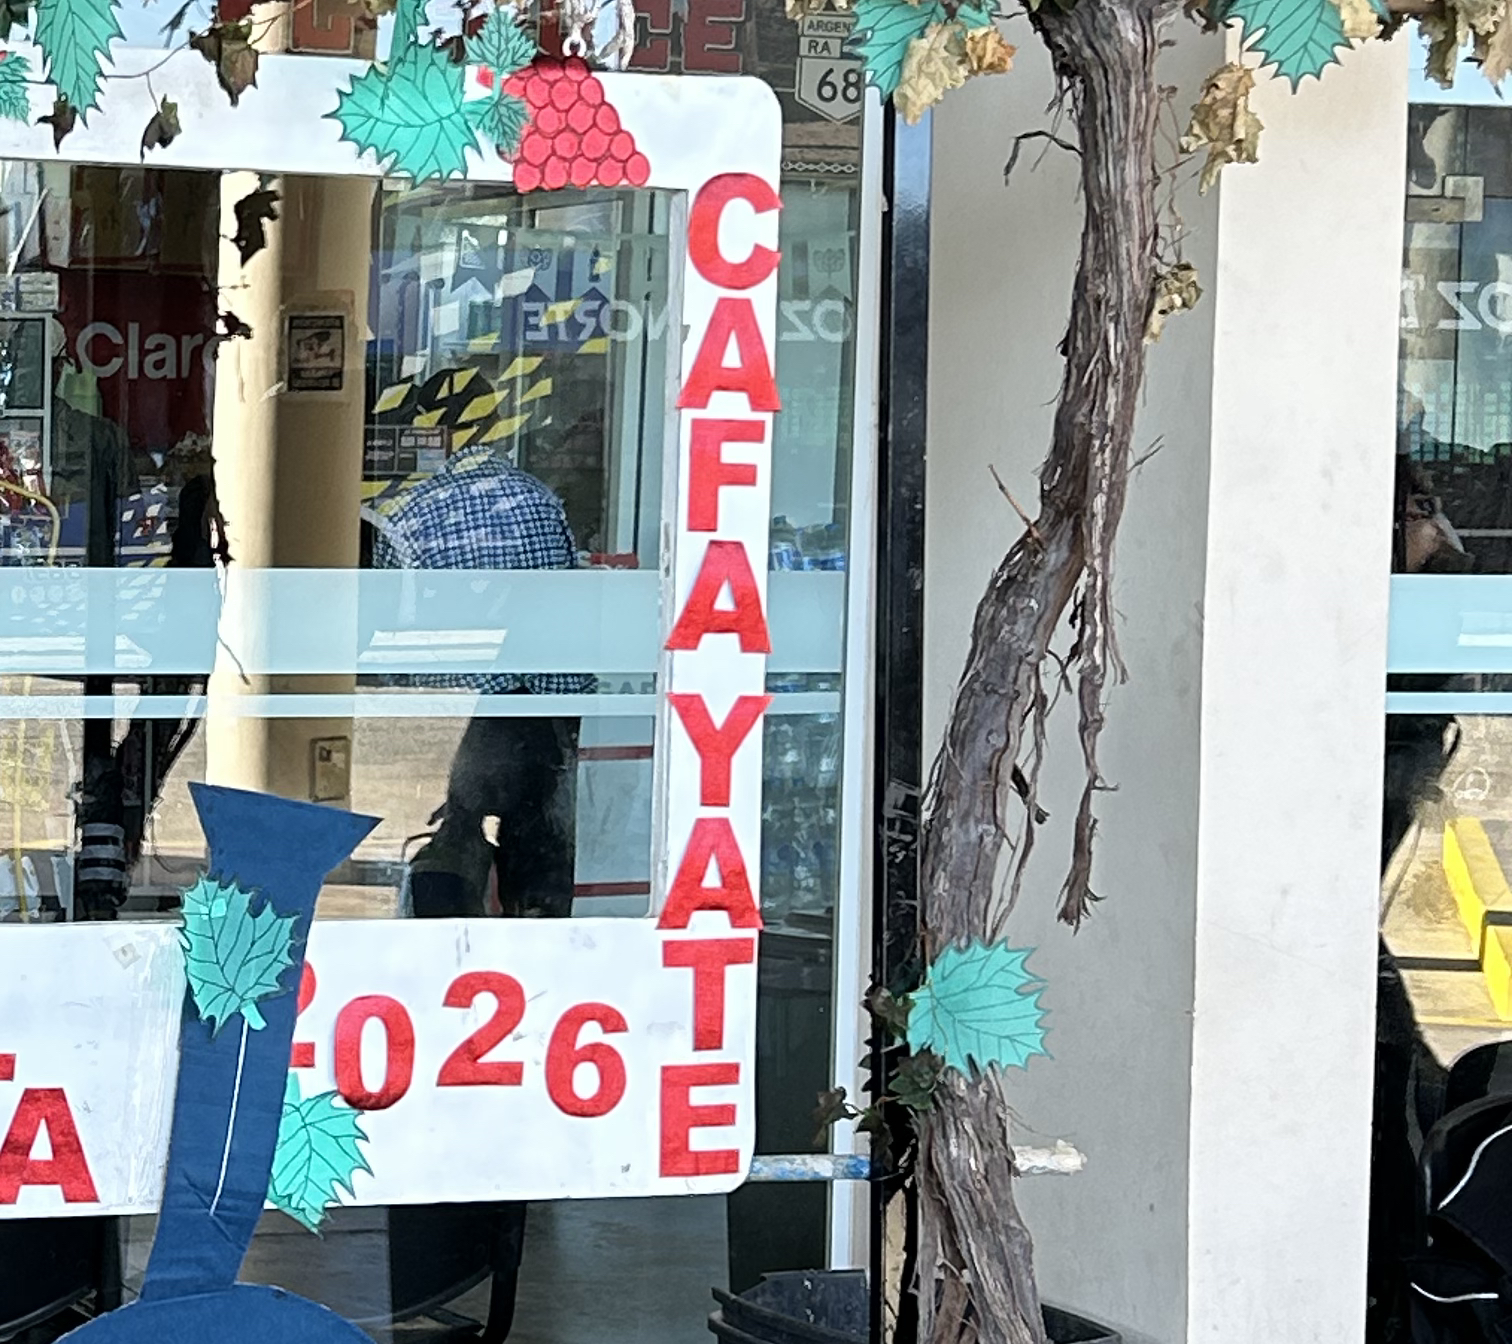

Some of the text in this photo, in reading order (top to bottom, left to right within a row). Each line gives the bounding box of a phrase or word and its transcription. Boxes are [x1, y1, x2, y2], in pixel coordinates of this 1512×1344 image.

[808, 39, 832, 55] RA
[816, 67, 861, 104] 68
[654, 172, 784, 1179] CAFAYATE
